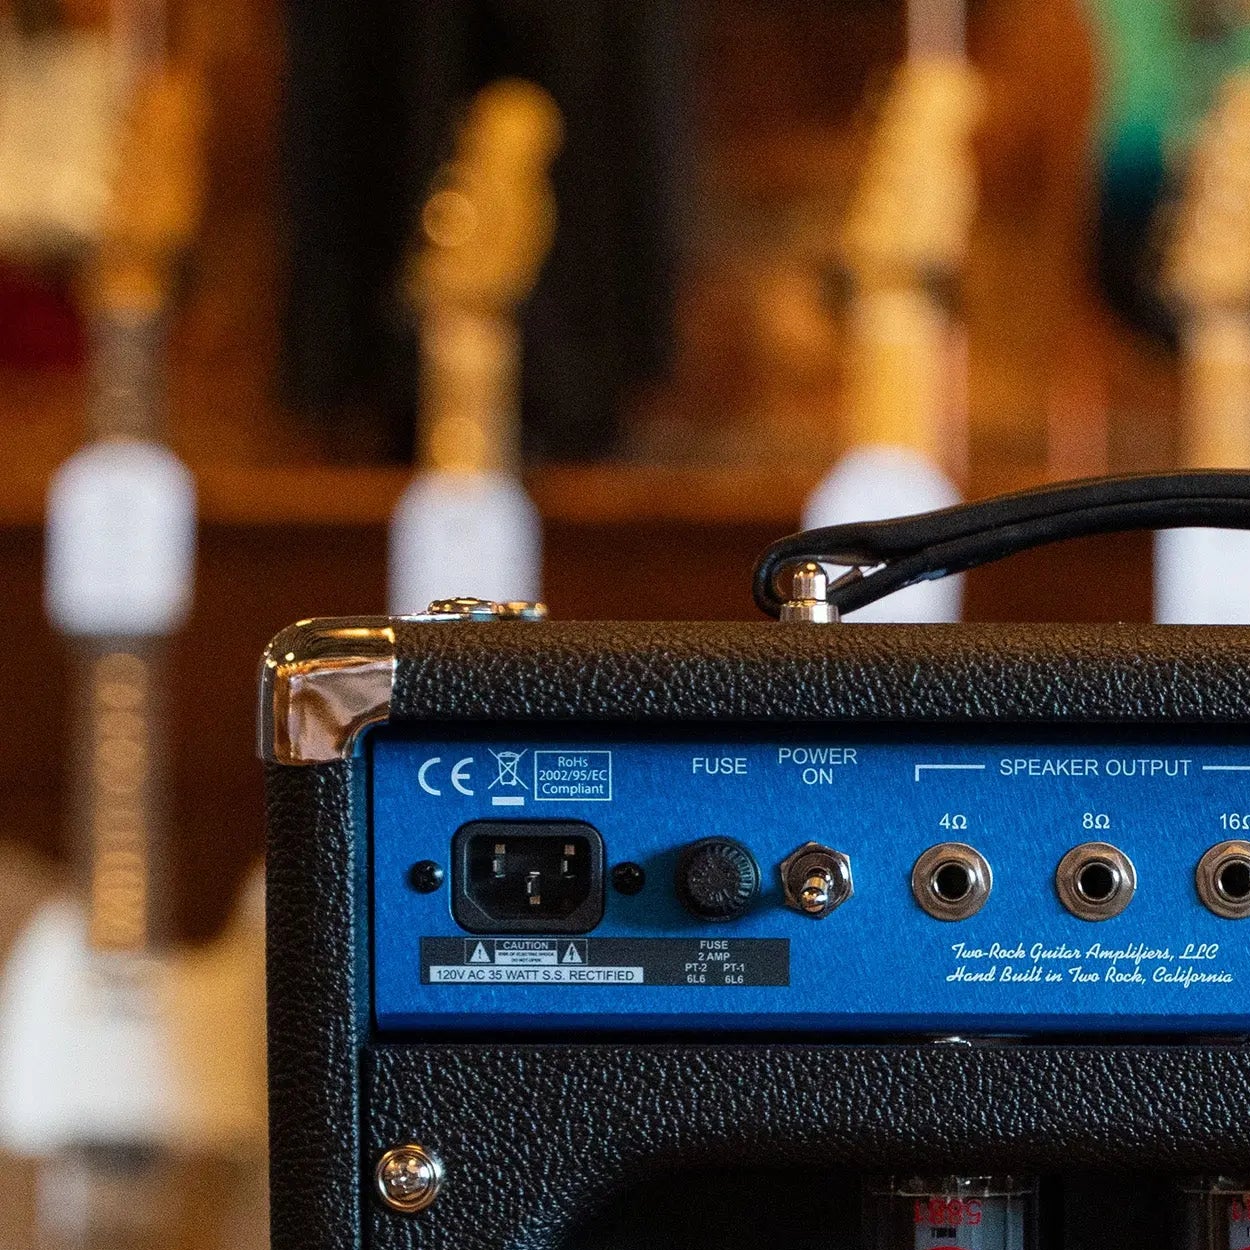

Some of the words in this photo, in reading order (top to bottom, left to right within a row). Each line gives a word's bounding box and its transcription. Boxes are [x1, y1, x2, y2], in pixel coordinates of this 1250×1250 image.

[558, 756, 588, 767] RoHs
[779, 748, 857, 764] POWER
[693, 758, 747, 774] FUSE
[1000, 759, 1098, 775] SPEAKER
[1106, 759, 1192, 776] OUTPUT
[539, 770, 607, 783] 2002/95/EC
[803, 768, 832, 785] ON
[542, 783, 603, 796] Compliant
[939, 813, 967, 829] 4Ω
[1083, 813, 1110, 829] 8Ω
[503, 941, 549, 950] CAUTION
[700, 940, 728, 949] FUSE
[698, 952, 704, 961] 2
[706, 952, 730, 961] AMP
[952, 943, 1026, 959] Two-Rock
[1030, 943, 1081, 962] Guitar
[1086, 943, 1174, 964] Amplifiers,
[1179, 944, 1219, 959] LLC
[685, 962, 707, 972] PT-2
[723, 963, 744, 972] PT-1
[437, 970, 466, 981] 120V
[467, 970, 485, 980] AC
[488, 970, 502, 980] 35
[505, 970, 539, 980] WATT
[542, 970, 565, 980] S.S.
[569, 970, 634, 981] RECTIFIED
[687, 974, 706, 983] 6L6
[725, 975, 743, 984] 6L6
[946, 966, 996, 981] Hand
[999, 966, 1043, 982] Built
[1045, 970, 1062, 982] in
[1068, 966, 1100, 982] Two
[1105, 966, 1146, 984] Rock,
[1153, 966, 1233, 988] California
